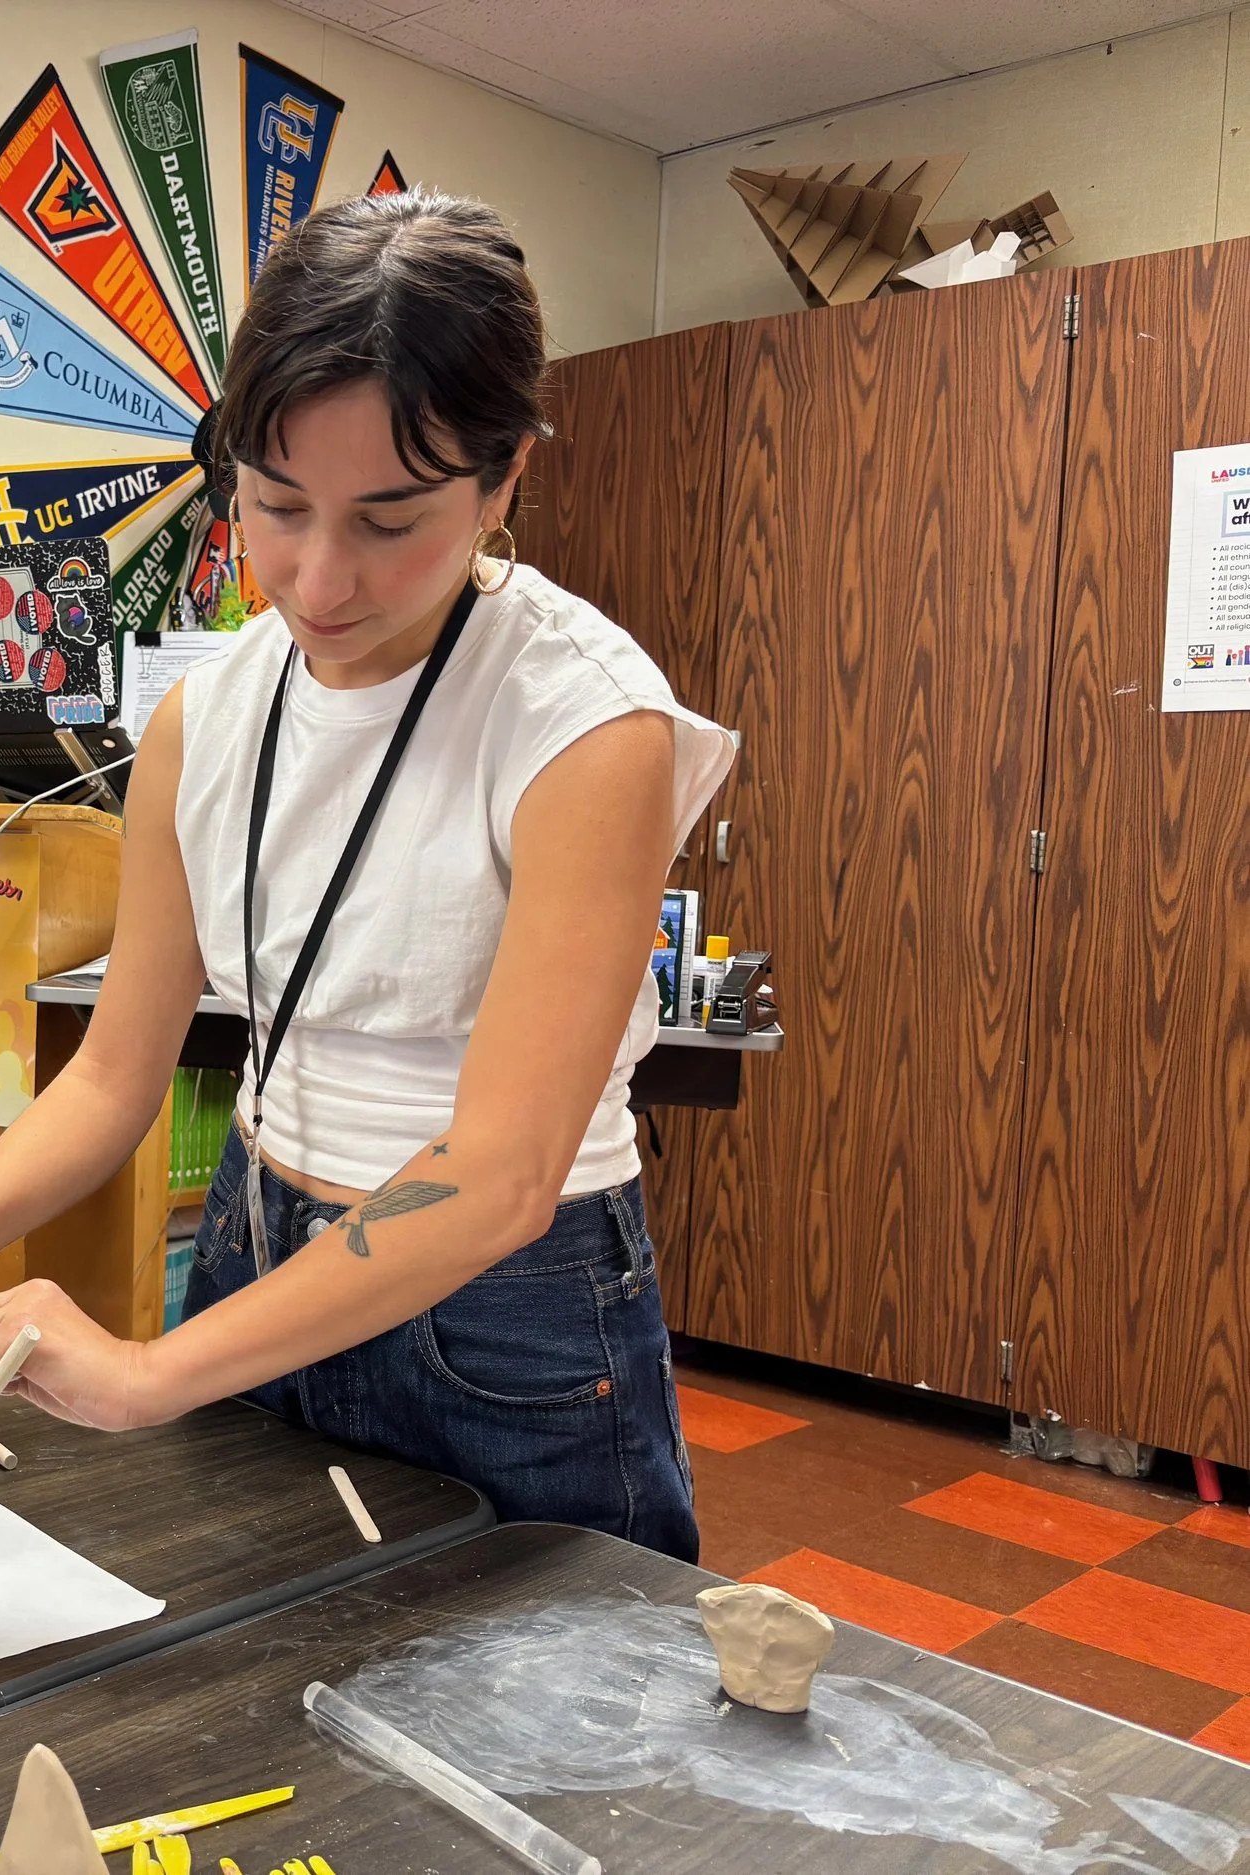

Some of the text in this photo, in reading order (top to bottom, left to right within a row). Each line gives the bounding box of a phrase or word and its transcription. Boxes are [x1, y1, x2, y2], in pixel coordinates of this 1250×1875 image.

[6, 120, 39, 167] GRANDE
[32, 89, 62, 131] VALLEY
[259, 164, 274, 240] HIGHLANDERS
[160, 151, 220, 338] DARTMOUTH
[93, 239, 191, 376] UTRGV
[34, 465, 161, 533] UC IRVINE
[61, 577, 77, 588] love
[86, 576, 102, 587] love
[1218, 554, 1229, 562] All
[26, 593, 38, 628] VOTED
[126, 565, 171, 631] STATE
[39, 650, 52, 683] VOTED
[50, 697, 104, 724] PRIDE
